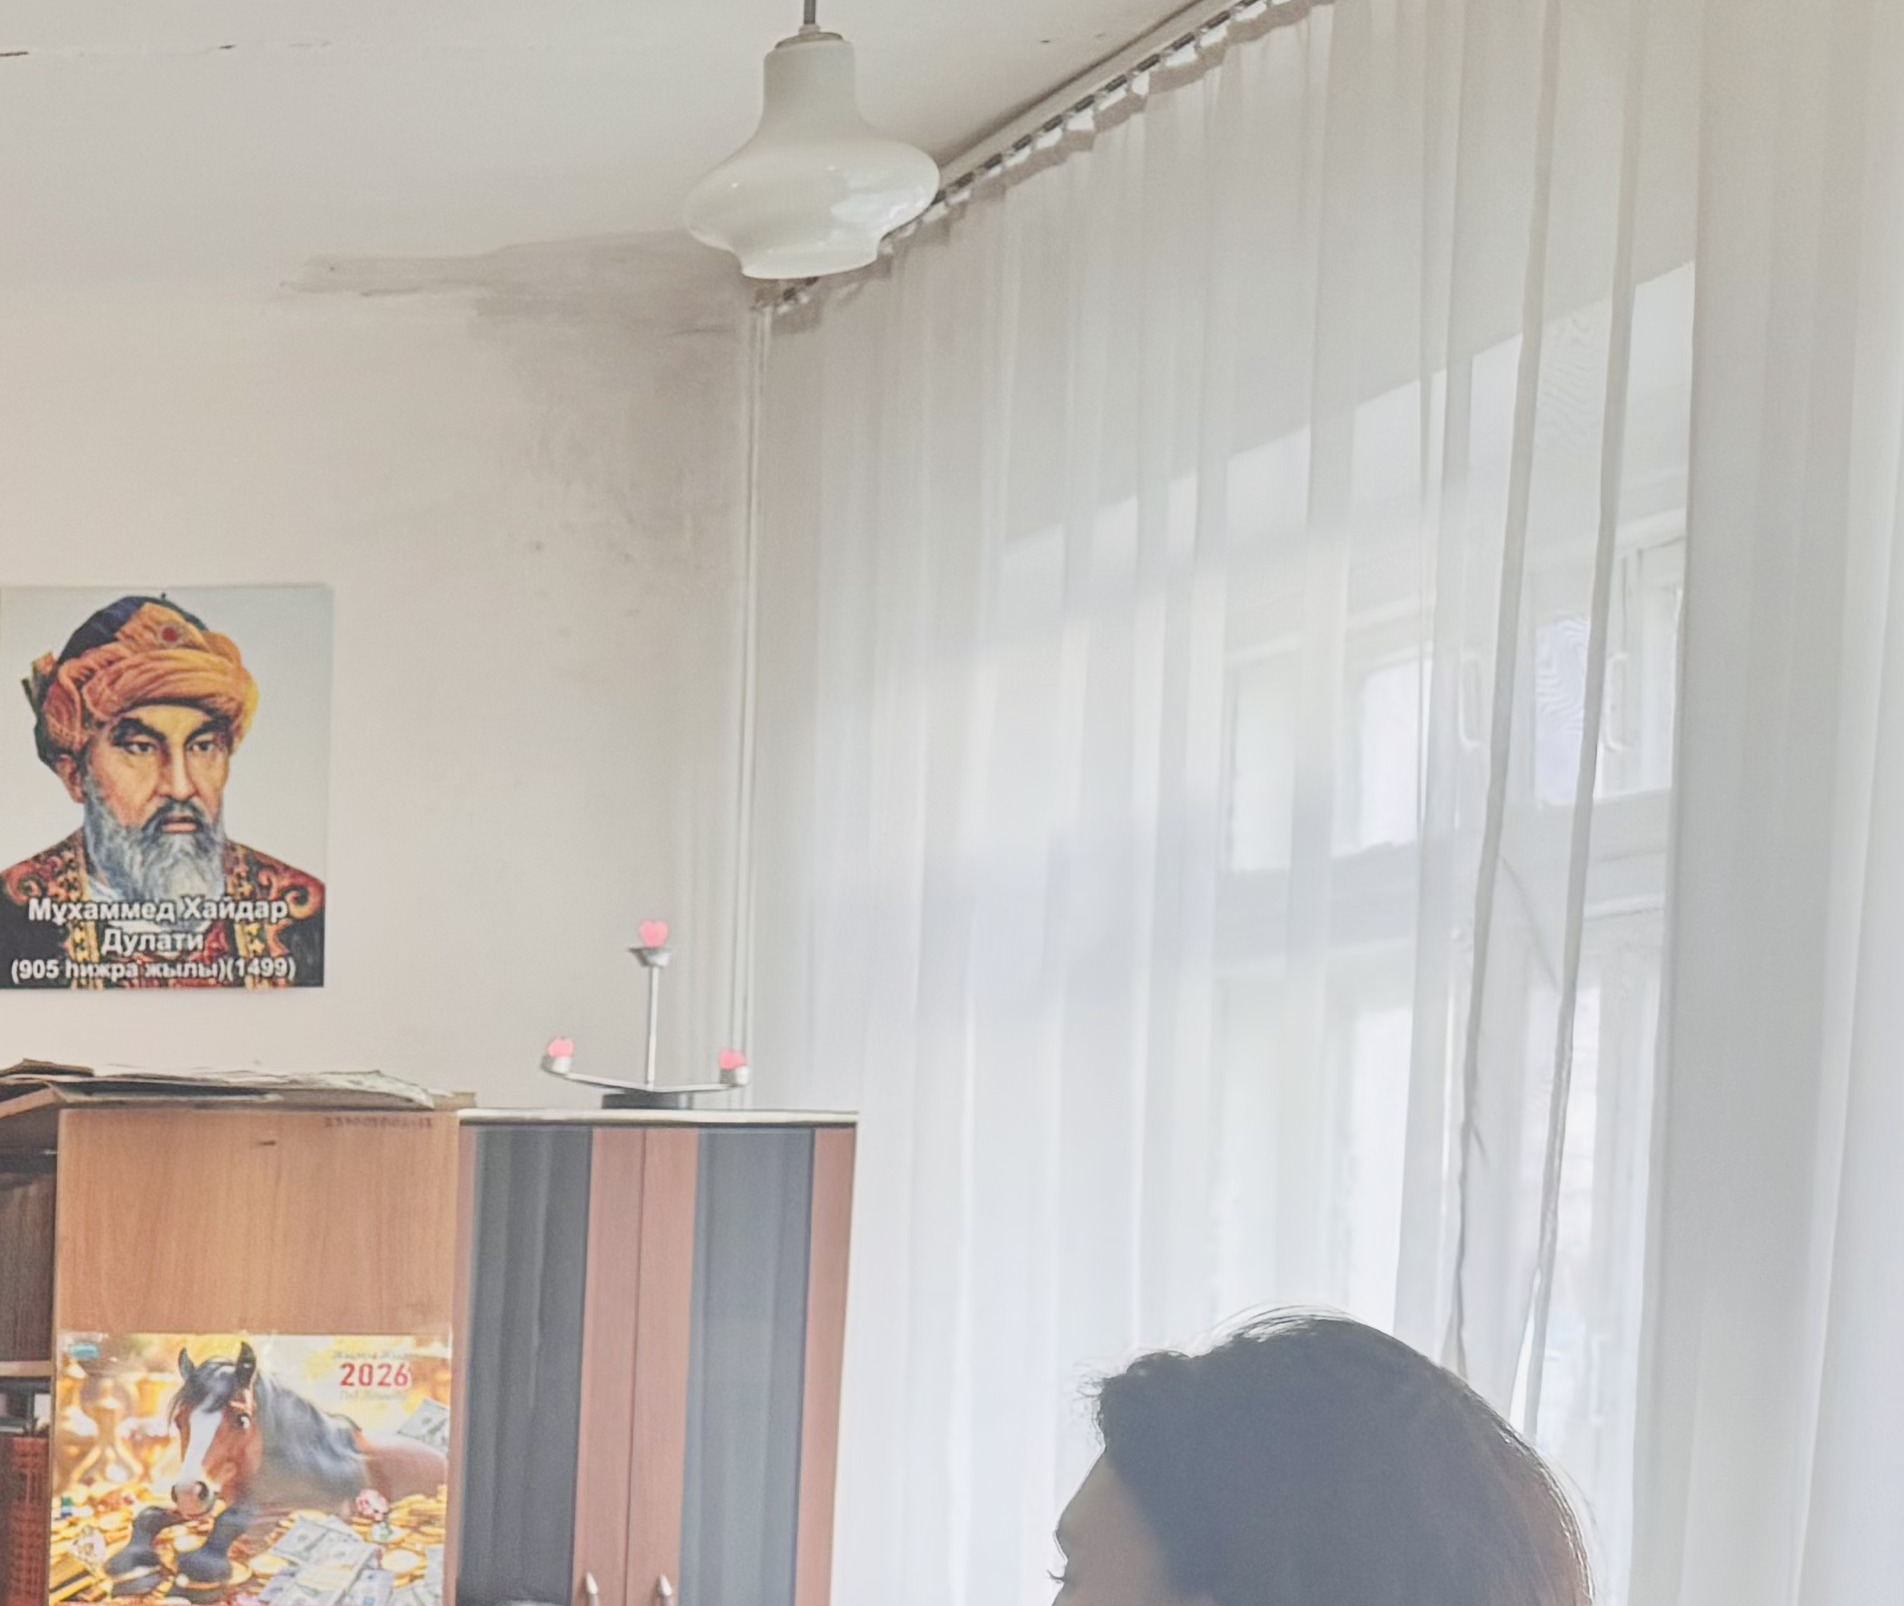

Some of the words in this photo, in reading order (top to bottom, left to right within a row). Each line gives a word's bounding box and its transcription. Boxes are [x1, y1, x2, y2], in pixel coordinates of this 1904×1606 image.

[28, 898, 175, 925] Мұхаммед
[183, 897, 288, 921] Хайдар
[101, 929, 204, 954] Дулати
[11, 958, 59, 984] (905
[339, 1362, 410, 1387] 2026
